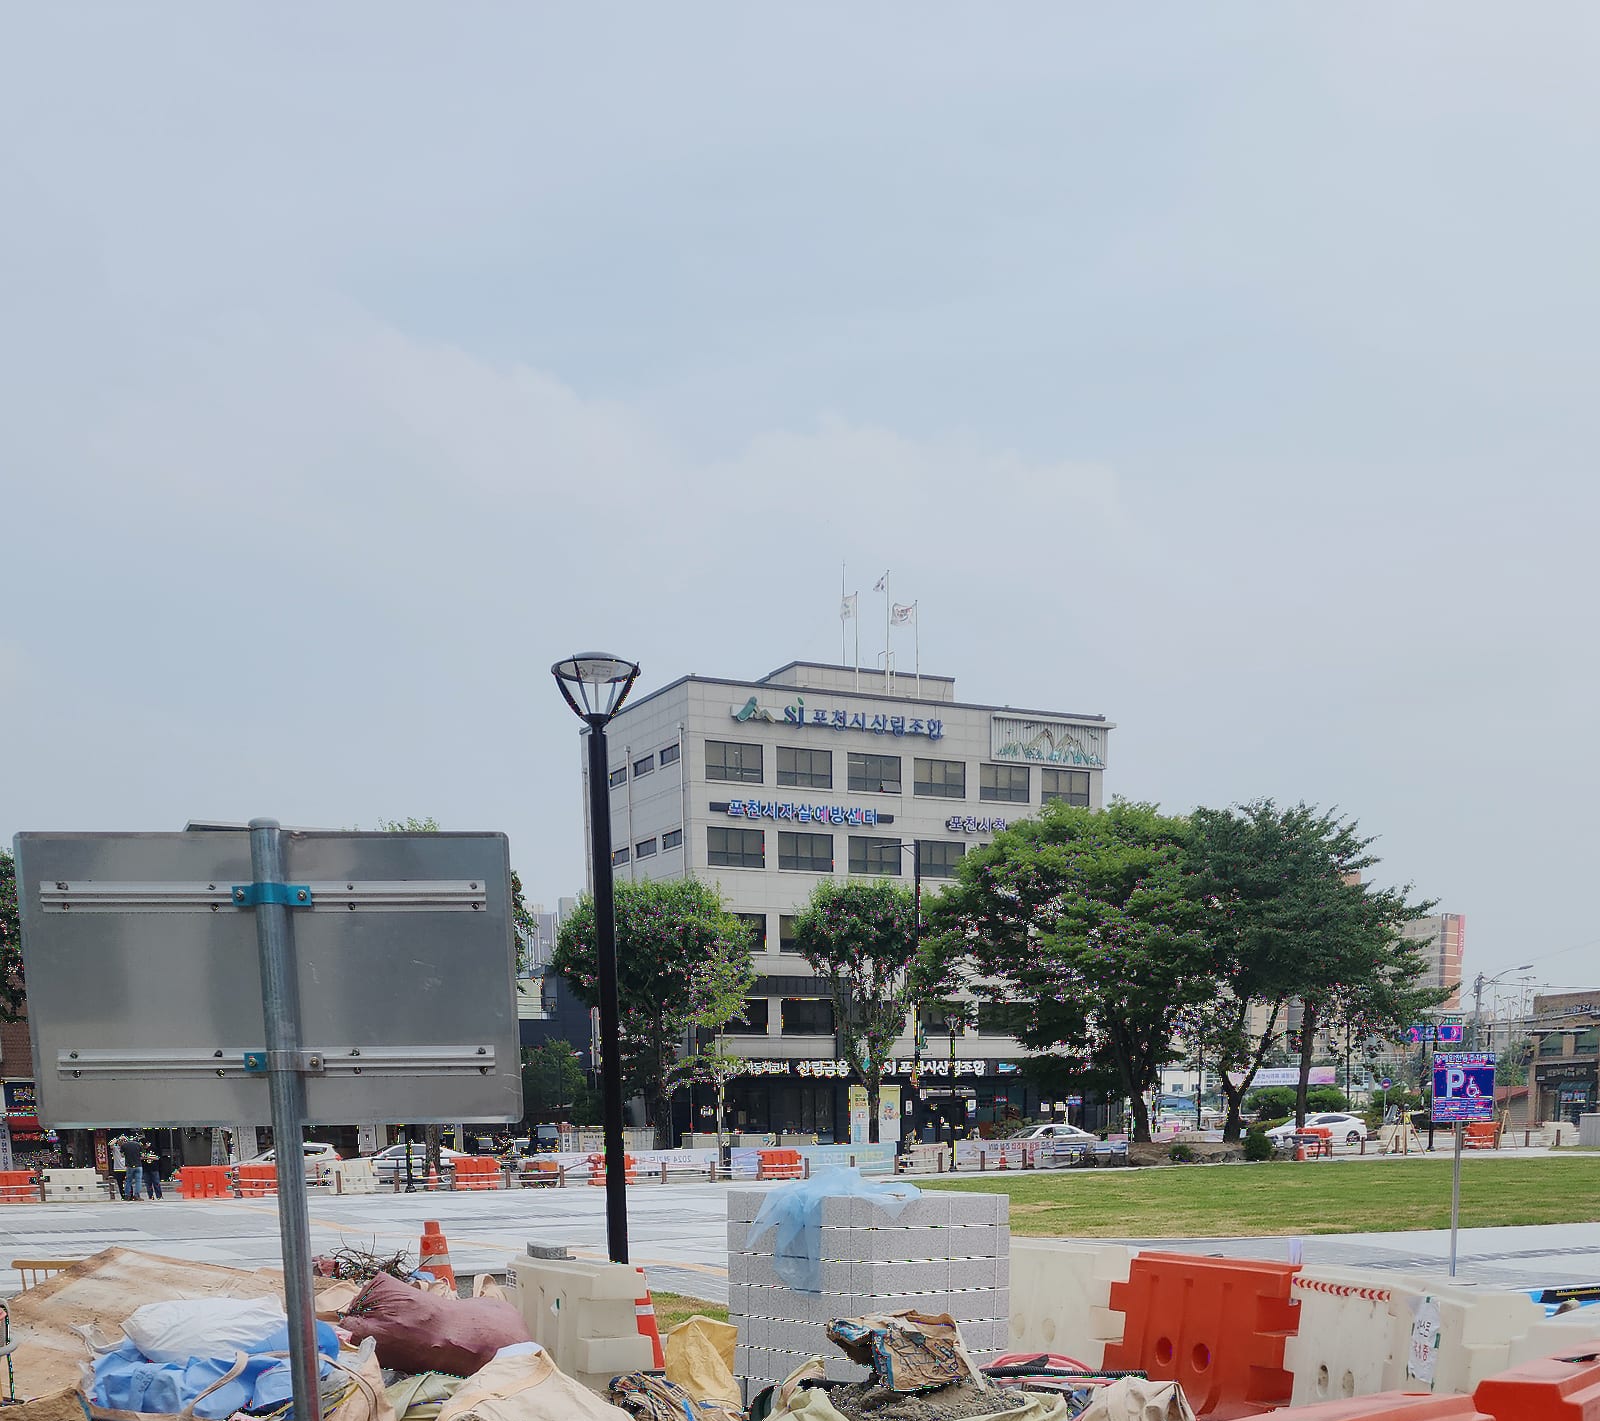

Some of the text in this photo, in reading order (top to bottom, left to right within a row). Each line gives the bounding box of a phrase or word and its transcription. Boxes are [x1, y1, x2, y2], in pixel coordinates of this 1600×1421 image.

[812, 708, 944, 741] 포천시산림조합
[728, 799, 879, 827] 포천시자살예방센터
[796, 1060, 851, 1077] 산림금융
[1446, 1069, 1465, 1098] P
